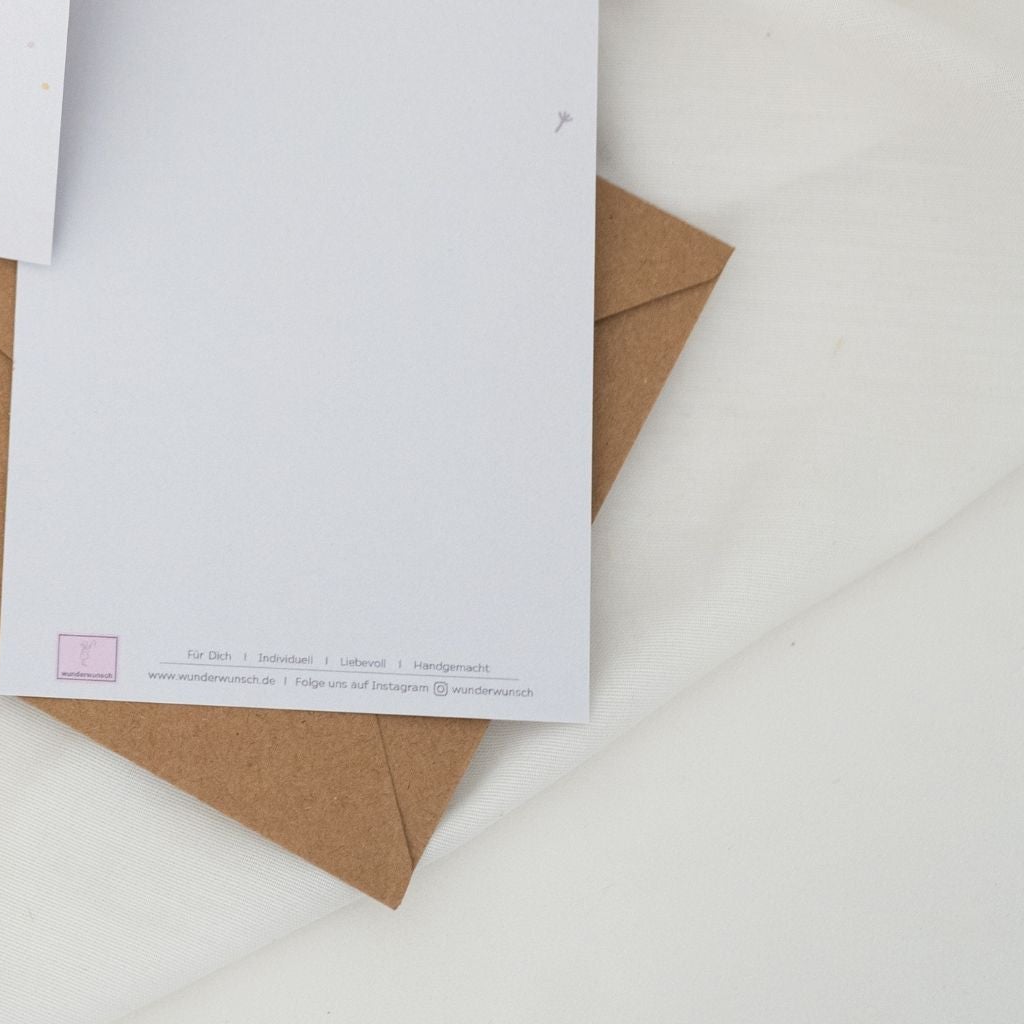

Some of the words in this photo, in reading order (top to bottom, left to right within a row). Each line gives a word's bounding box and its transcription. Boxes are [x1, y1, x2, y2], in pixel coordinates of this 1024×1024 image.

[187, 649, 204, 660] Für
[208, 650, 232, 661] Dich
[258, 653, 314, 665] Individuell
[340, 657, 387, 669] Liebevoll
[413, 660, 491, 674] Handgemacht
[148, 670, 276, 686] www.wunderwunsch.de
[295, 677, 325, 690] Folge
[328, 680, 348, 689] uns
[350, 680, 370, 690] auf
[372, 681, 429, 694] Instagram
[452, 685, 534, 697] wunderwunsch
